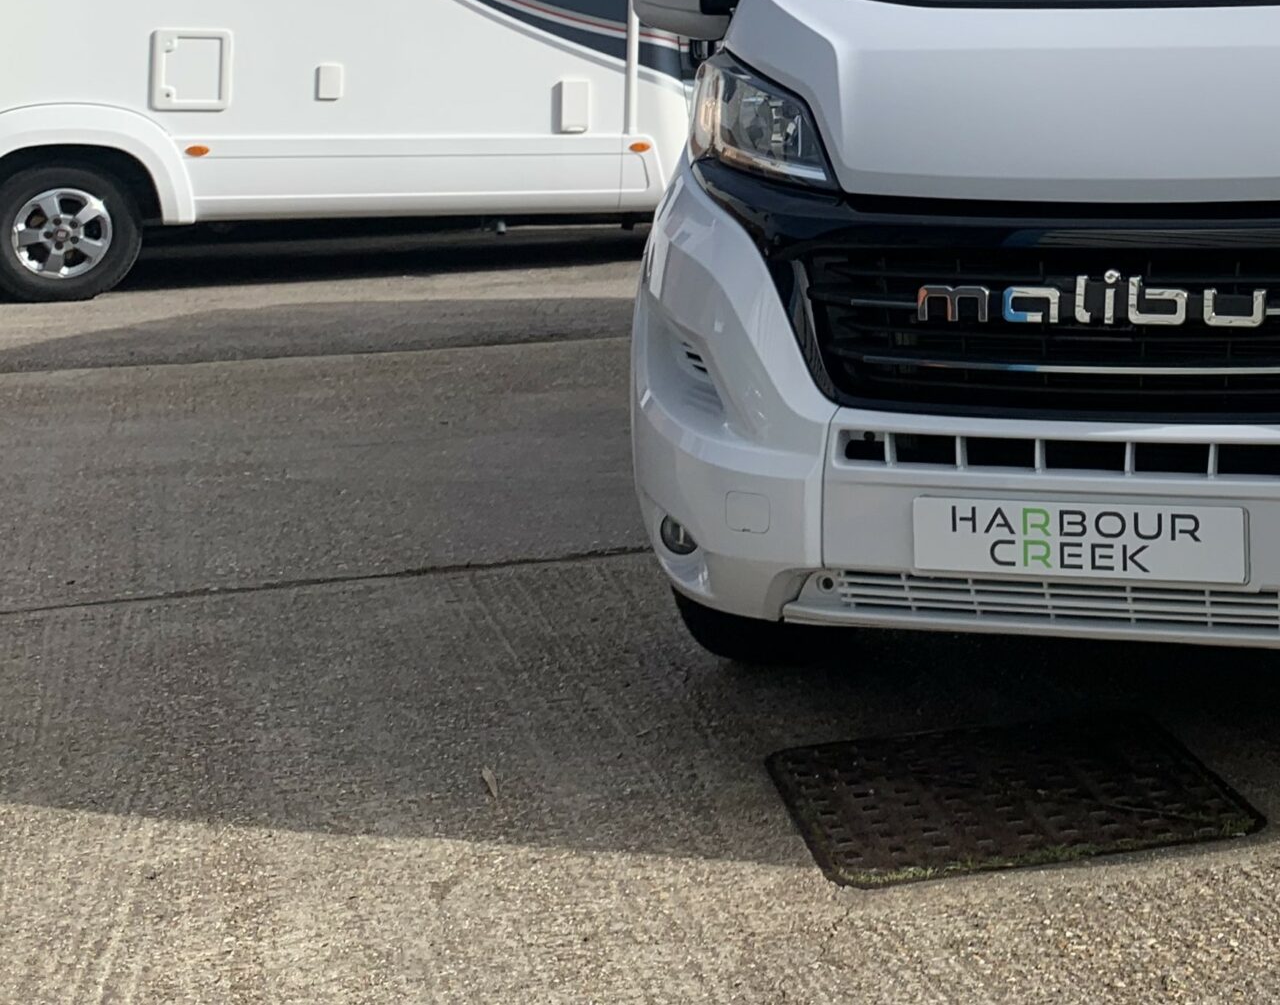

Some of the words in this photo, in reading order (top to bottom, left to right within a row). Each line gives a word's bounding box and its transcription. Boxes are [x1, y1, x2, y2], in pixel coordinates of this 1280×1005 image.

[917, 268, 1267, 327] malibu
[951, 504, 1202, 543] HARBOUR
[989, 538, 1150, 573] CREEK
